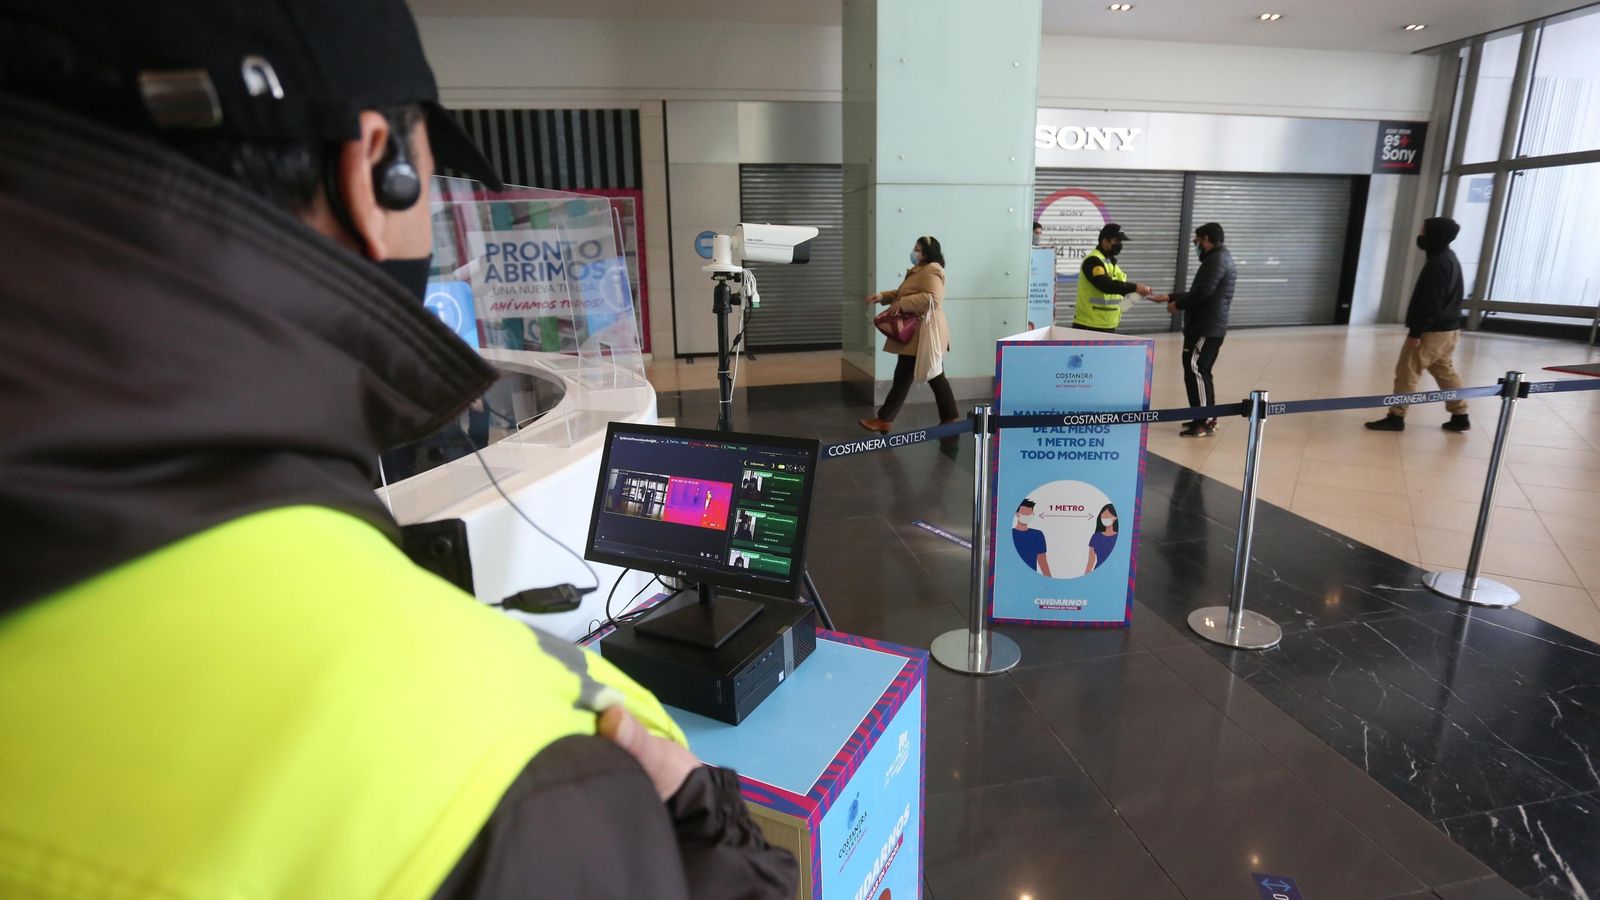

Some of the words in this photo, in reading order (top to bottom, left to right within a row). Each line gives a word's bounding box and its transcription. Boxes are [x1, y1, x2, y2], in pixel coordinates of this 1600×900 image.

[1035, 124, 1141, 151] SONY
[1381, 145, 1417, 164] Sony
[484, 239, 602, 263] PRONTO
[1068, 246, 1087, 258] hrs
[484, 260, 607, 284] ABRIMOS
[492, 285, 517, 296] UNA
[518, 284, 556, 295] NUEVA
[513, 299, 557, 311] VAMOS
[1528, 383, 1556, 393] ENTER
[1383, 393, 1427, 406] COSTANERA
[1427, 390, 1457, 402] CENTER
[1063, 414, 1120, 425] COSTANERA
[1121, 411, 1159, 422] CENTER
[1033, 426, 1048, 434] DE
[1050, 426, 1066, 434] AL
[1067, 424, 1111, 434] MENOS
[828, 438, 887, 457] COSTANERA
[888, 430, 927, 447] CENTER
[1037, 438, 1042, 447] 1
[1045, 438, 1087, 447] METRO
[1089, 438, 1105, 448] EN
[1020, 450, 1055, 460] TODO
[1057, 450, 1120, 461] MOMENTO
[1033, 598, 1088, 607] CUIDARNOS
[854, 802, 910, 900] IDARNOS
